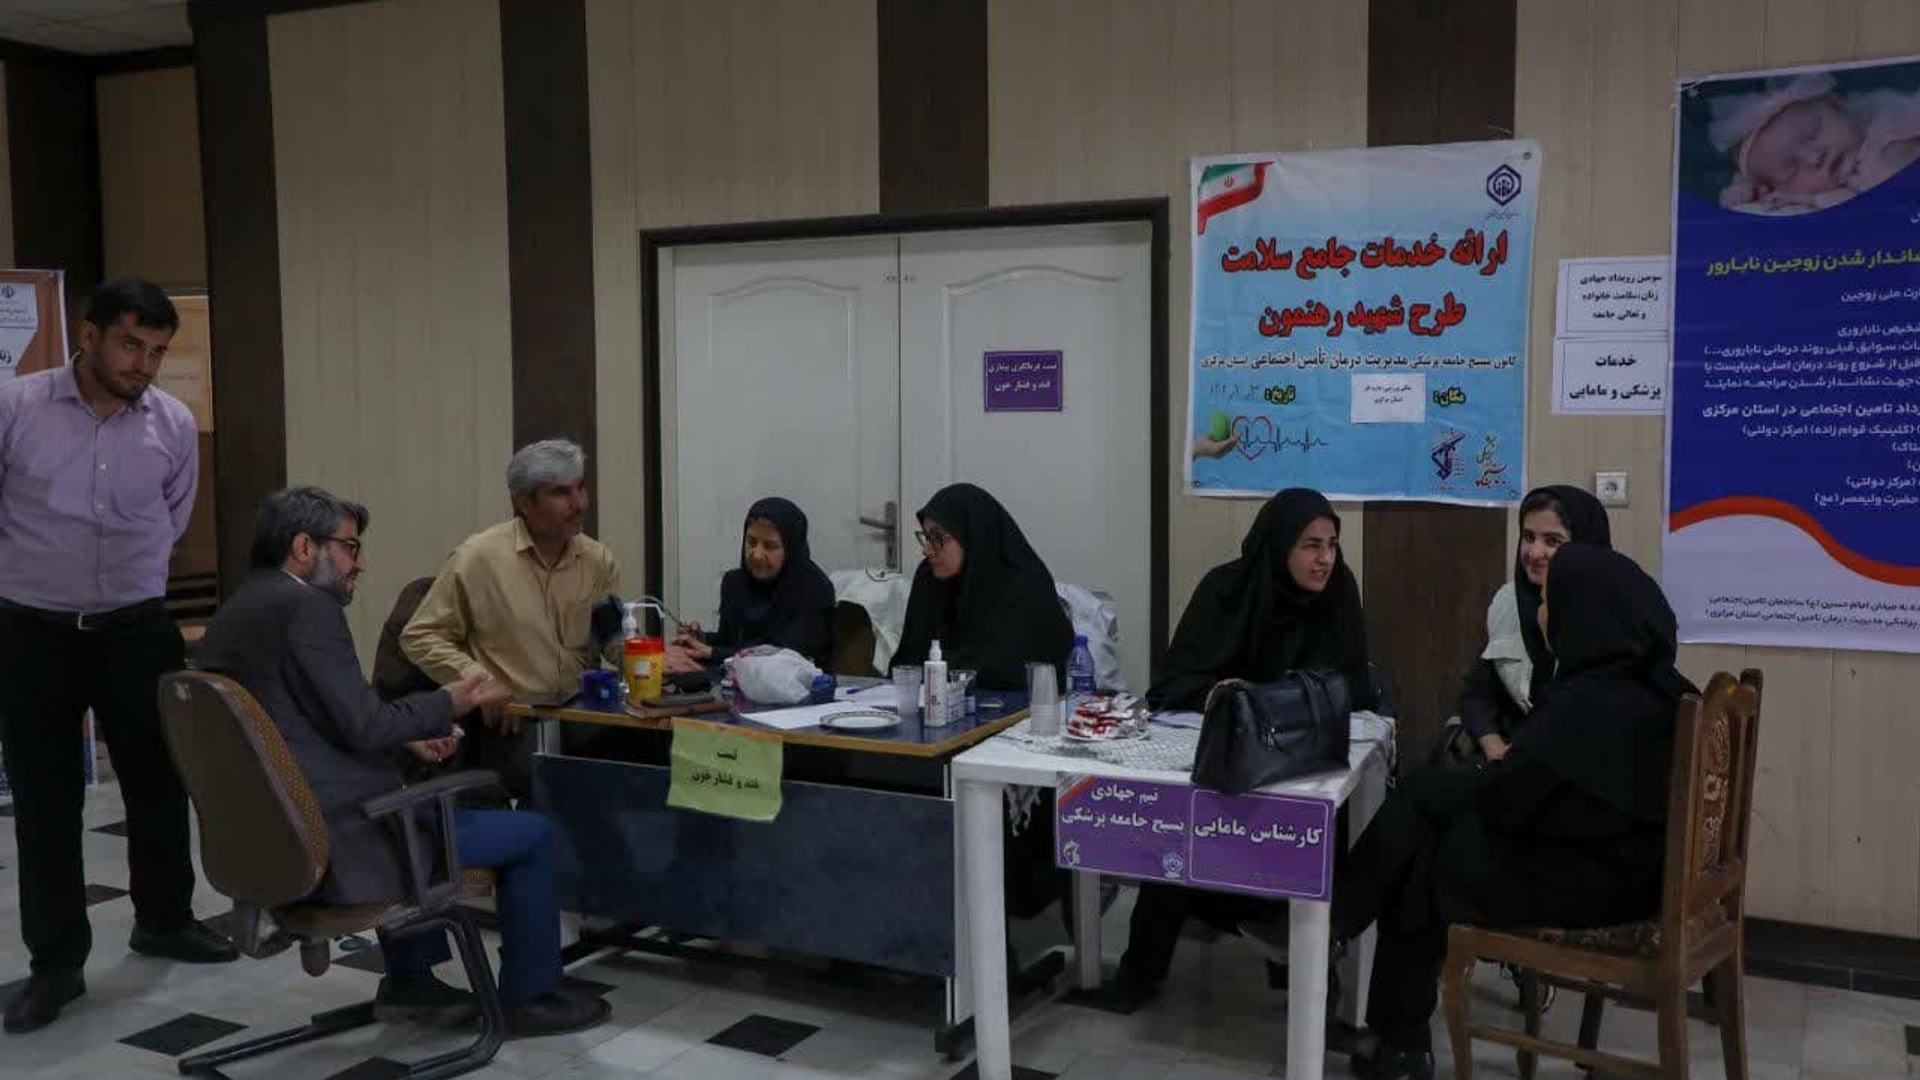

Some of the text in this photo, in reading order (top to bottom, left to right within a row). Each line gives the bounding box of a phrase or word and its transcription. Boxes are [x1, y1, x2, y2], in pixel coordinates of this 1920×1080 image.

[1222, 228, 1508, 279] ارائه خدمات جامع سلامت
[1823, 250, 1865, 270] شدن
[1706, 257, 1760, 275] نابارور
[1763, 254, 1820, 274] زوجین
[1580, 273, 1606, 285] جهادی
[1840, 289, 1876, 302] زوجین
[1259, 291, 1467, 337] طرح شهید رهنمون
[1641, 311, 1647, 320] و
[1837, 324, 1880, 338] ناباروری
[1251, 351, 1296, 370] اجتماعی
[1329, 351, 1361, 370] درمان
[1365, 352, 1408, 370] مدیریت
[1595, 354, 1637, 367] خدمات
[1792, 360, 1823, 372] درمان
[1851, 358, 1885, 372] شروع
[1264, 383, 1296, 406] تاریخ:
[1432, 384, 1467, 408] مکان:
[1569, 384, 1661, 400] پزشکی و مامایی
[1702, 404, 1739, 418] مرکزی
[1742, 404, 1779, 417] استان
[1782, 404, 1797, 417] در
[1800, 403, 1851, 417] اجتماعی
[1855, 403, 1893, 416] تامین
[1091, 783, 1135, 801] جهادی
[1062, 807, 1185, 832] بسیج جامعه پزشکی
[1195, 817, 1323, 848] کارشناس مامایی
